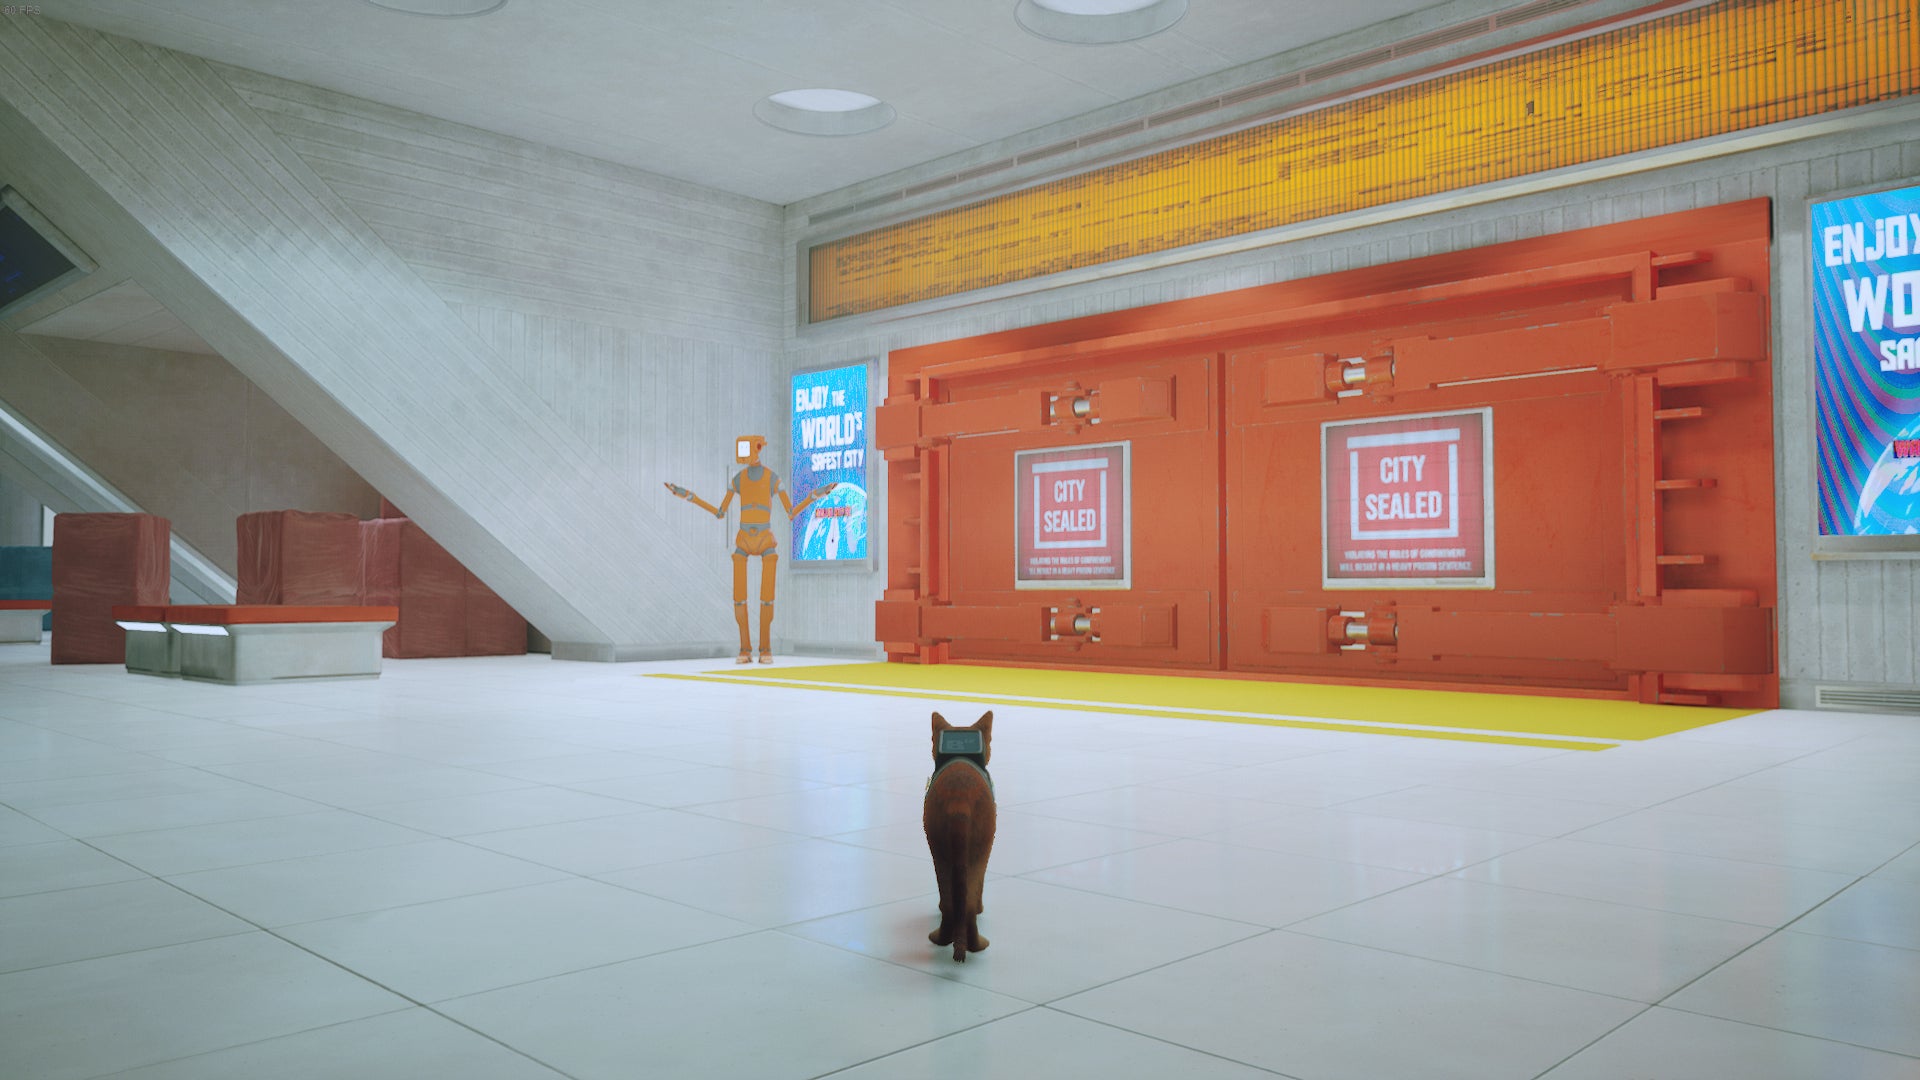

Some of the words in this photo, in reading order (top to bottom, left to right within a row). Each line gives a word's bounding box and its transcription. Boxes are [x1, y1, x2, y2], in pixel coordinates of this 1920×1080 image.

[1880, 336, 1920, 372] SA
[796, 385, 828, 412] ENJOY
[832, 390, 845, 407] THE
[811, 451, 842, 472] SAFEST
[844, 449, 864, 468] CITY
[1380, 455, 1426, 483] CITY
[1053, 479, 1086, 503] CITY
[1364, 490, 1443, 521] SEALED
[1043, 508, 1096, 533] SEALED
